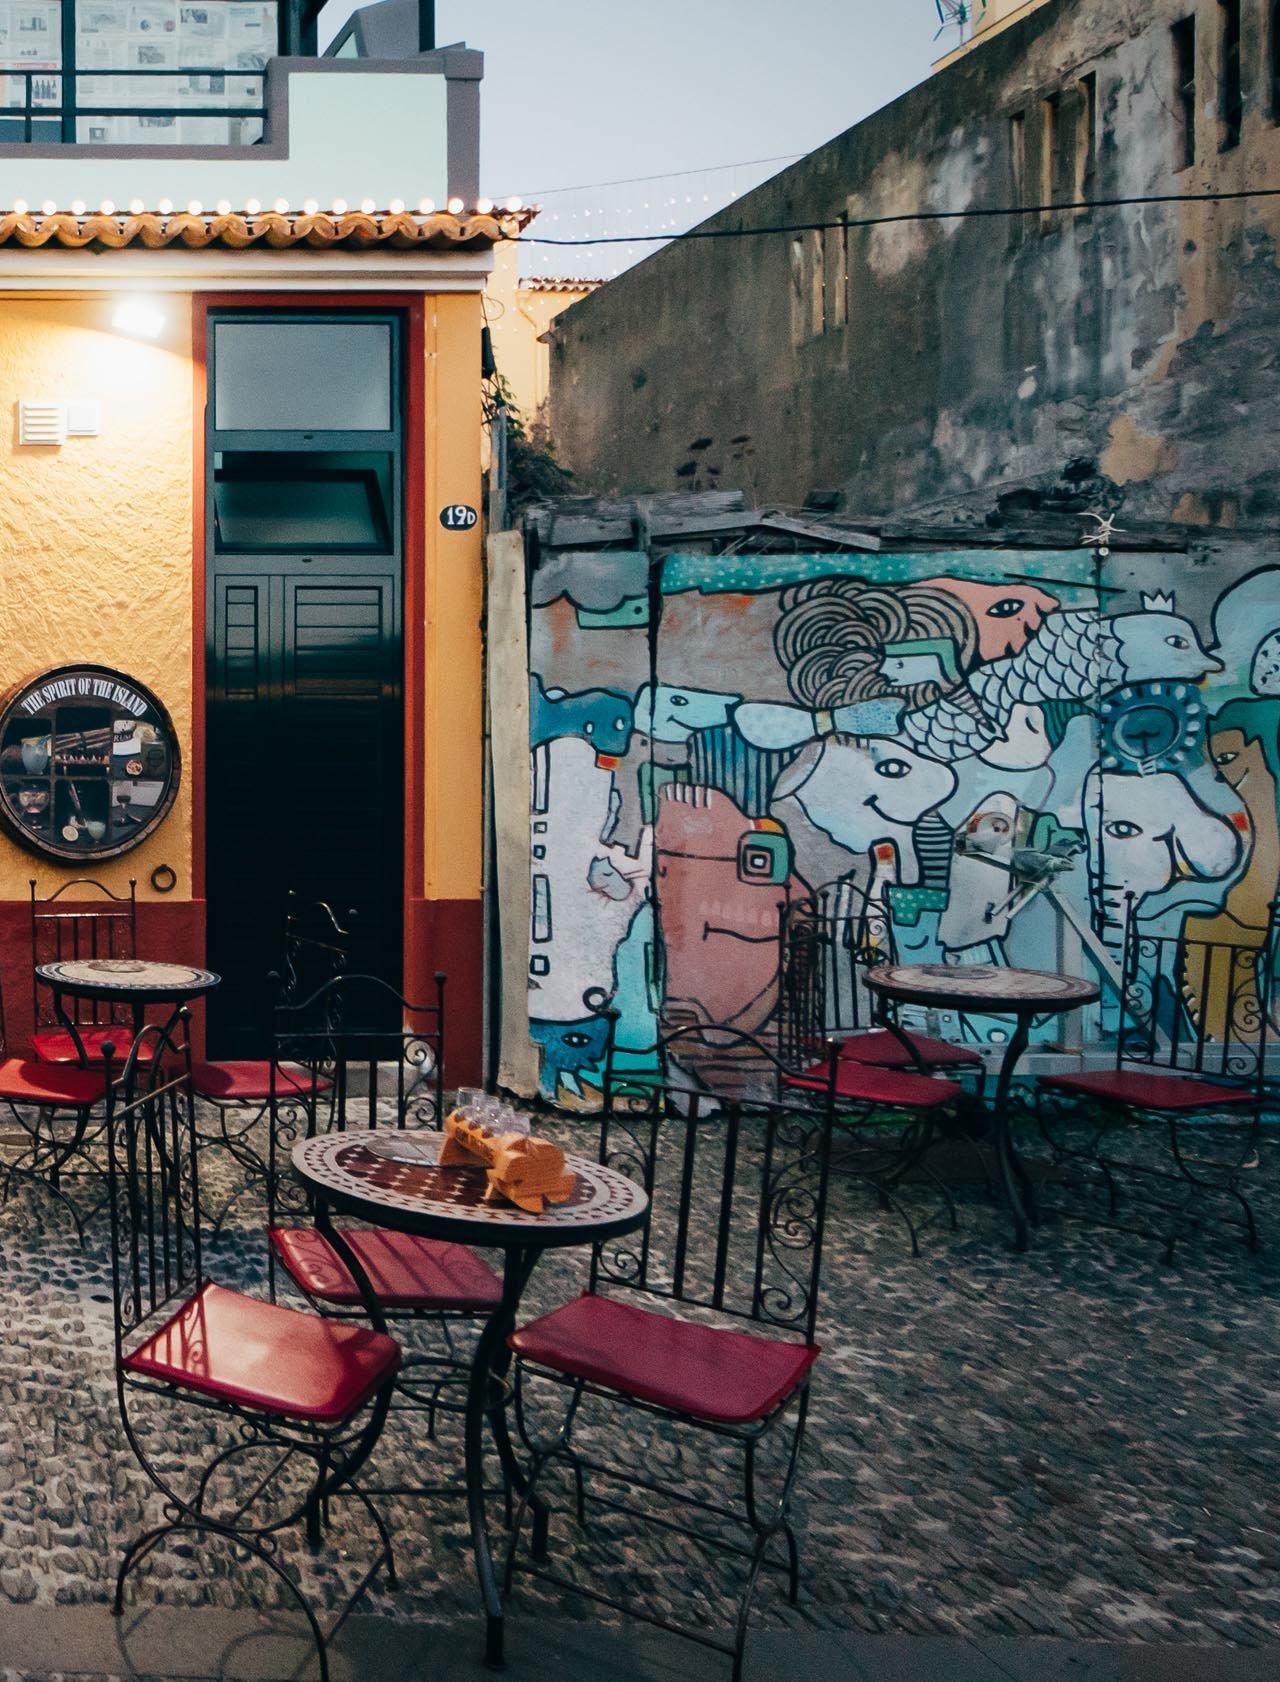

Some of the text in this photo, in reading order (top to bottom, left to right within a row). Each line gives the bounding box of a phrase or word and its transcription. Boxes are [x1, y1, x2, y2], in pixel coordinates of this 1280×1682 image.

[21, 678, 148, 717] THE SPIRIT OF THE ISLAND
